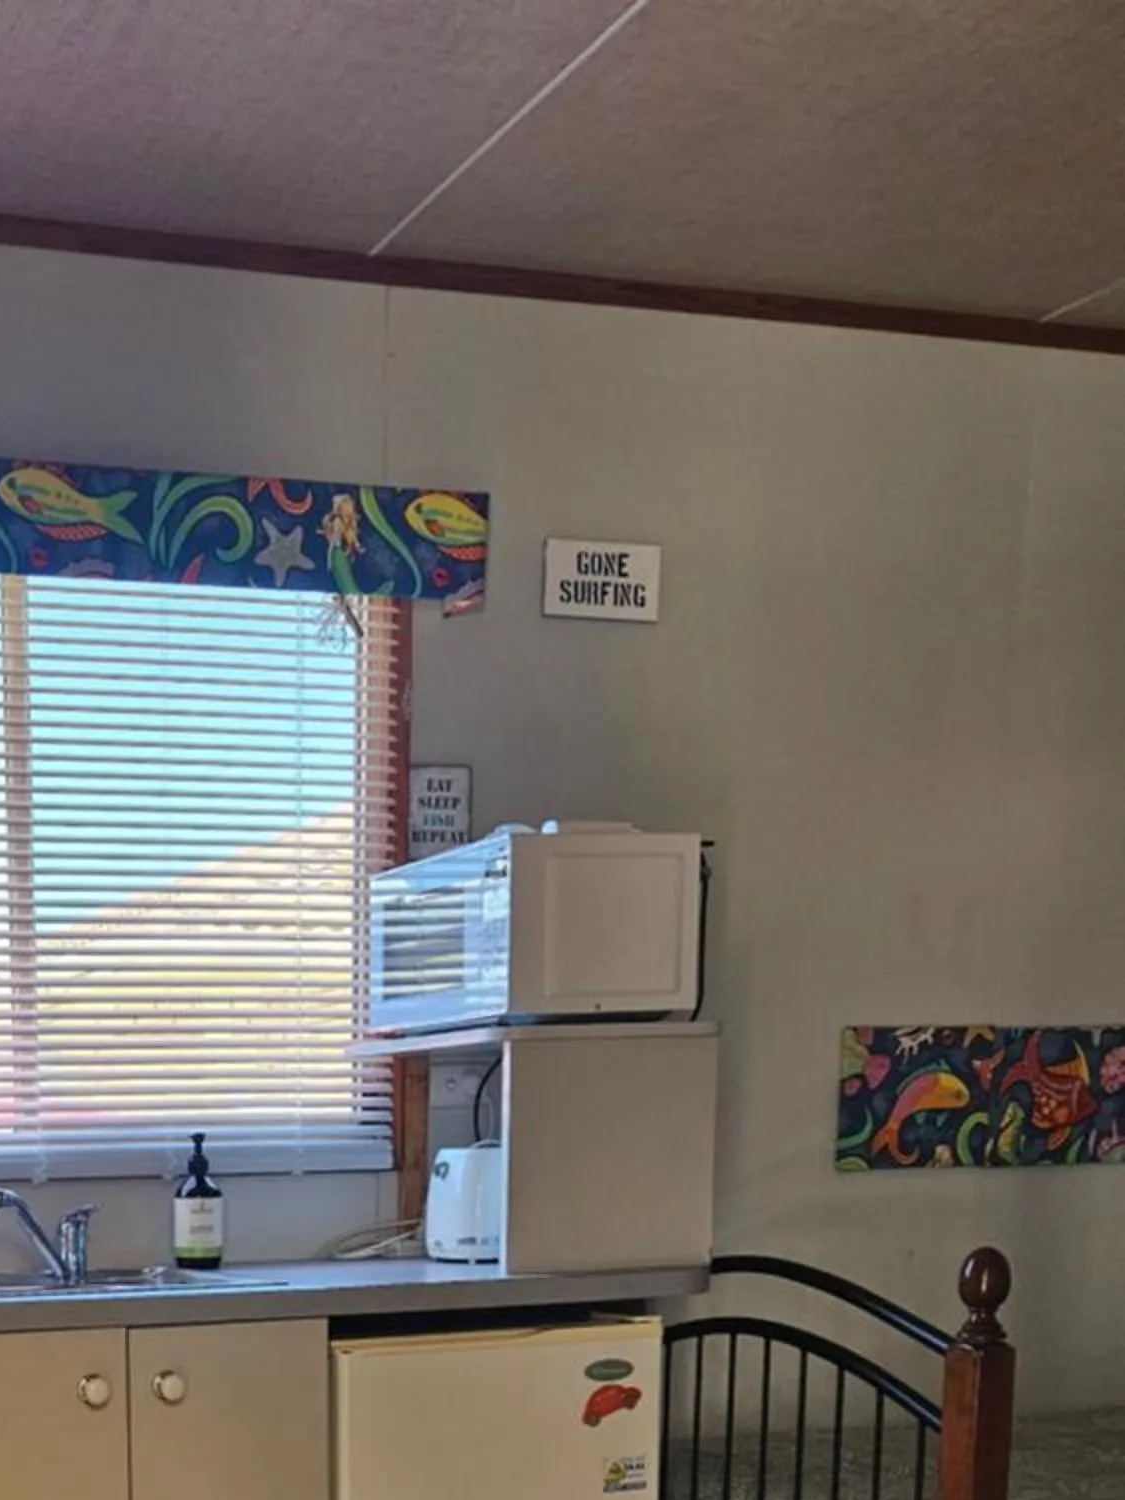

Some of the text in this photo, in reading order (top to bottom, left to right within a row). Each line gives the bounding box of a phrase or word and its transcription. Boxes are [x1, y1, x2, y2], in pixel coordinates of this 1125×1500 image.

[577, 551, 629, 577] GONE
[559, 579, 646, 608] SURFING
[426, 778, 452, 792] EAT
[418, 797, 461, 809] SLEEP
[411, 831, 467, 844] REPEAT
